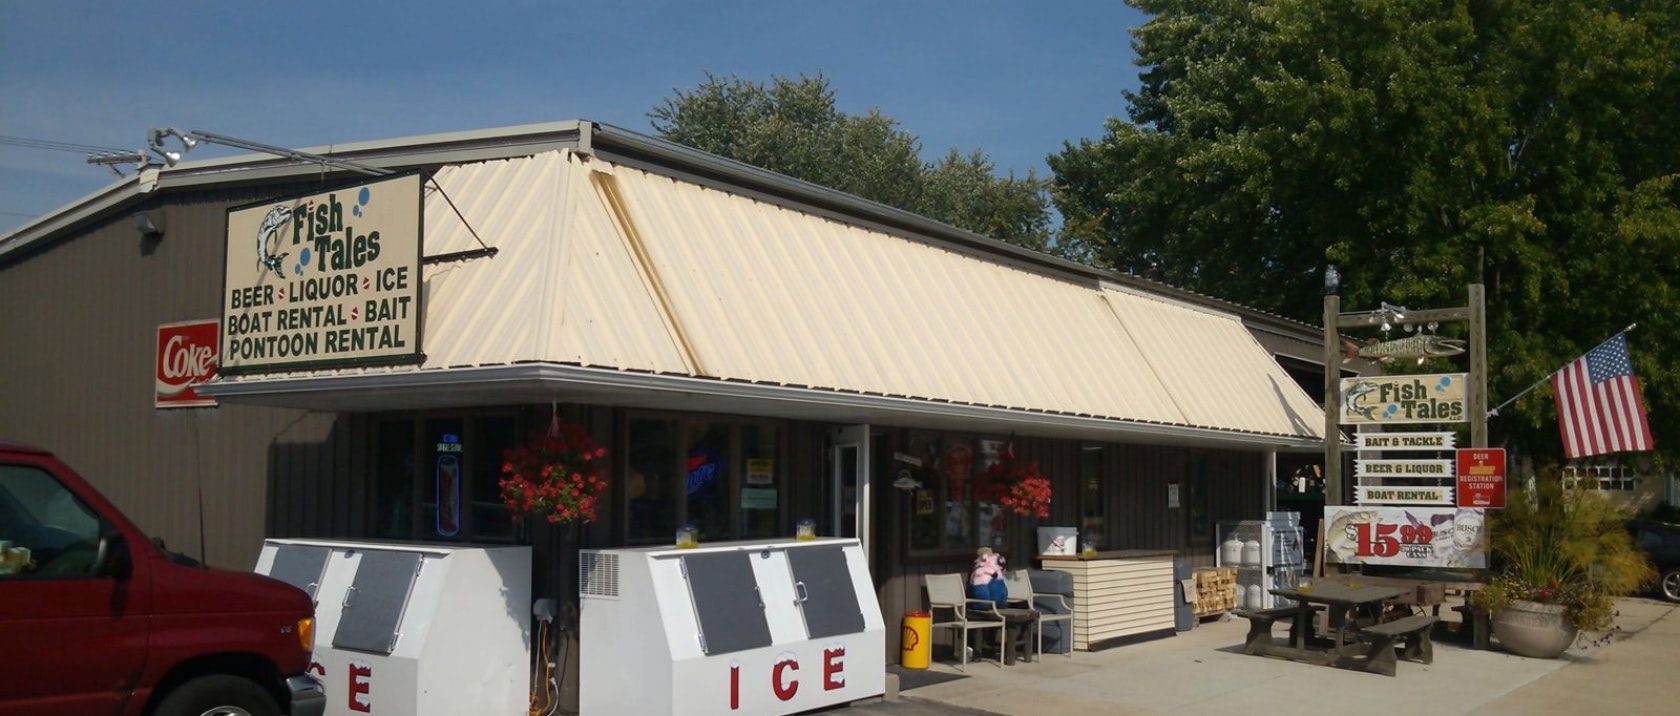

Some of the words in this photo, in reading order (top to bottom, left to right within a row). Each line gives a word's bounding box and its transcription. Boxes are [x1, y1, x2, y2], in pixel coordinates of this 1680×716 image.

[292, 194, 343, 245] Fish
[314, 227, 380, 272] Tales
[231, 285, 274, 309] BEER
[289, 273, 358, 303] LIQUOR
[376, 266, 408, 292] ICE
[228, 311, 272, 335] BOAT
[277, 306, 346, 331] RENTAL
[364, 296, 411, 322] BAIT
[163, 335, 212, 378] Coke
[229, 332, 318, 360] PONTOON
[325, 325, 405, 354] RENTAL
[1380, 379, 1427, 403] Fish
[1401, 398, 1462, 419] Tales
[1365, 438, 1389, 447] BAIT
[1392, 437, 1399, 446] &
[1402, 437, 1443, 446] TACKLE
[1365, 464, 1392, 473] BEER
[1395, 465, 1402, 473] &
[1405, 464, 1443, 474] LIQUOR
[1367, 491, 1394, 499] BOAT
[1397, 491, 1438, 500] RENTAL
[730, 643, 845, 710] ICE
